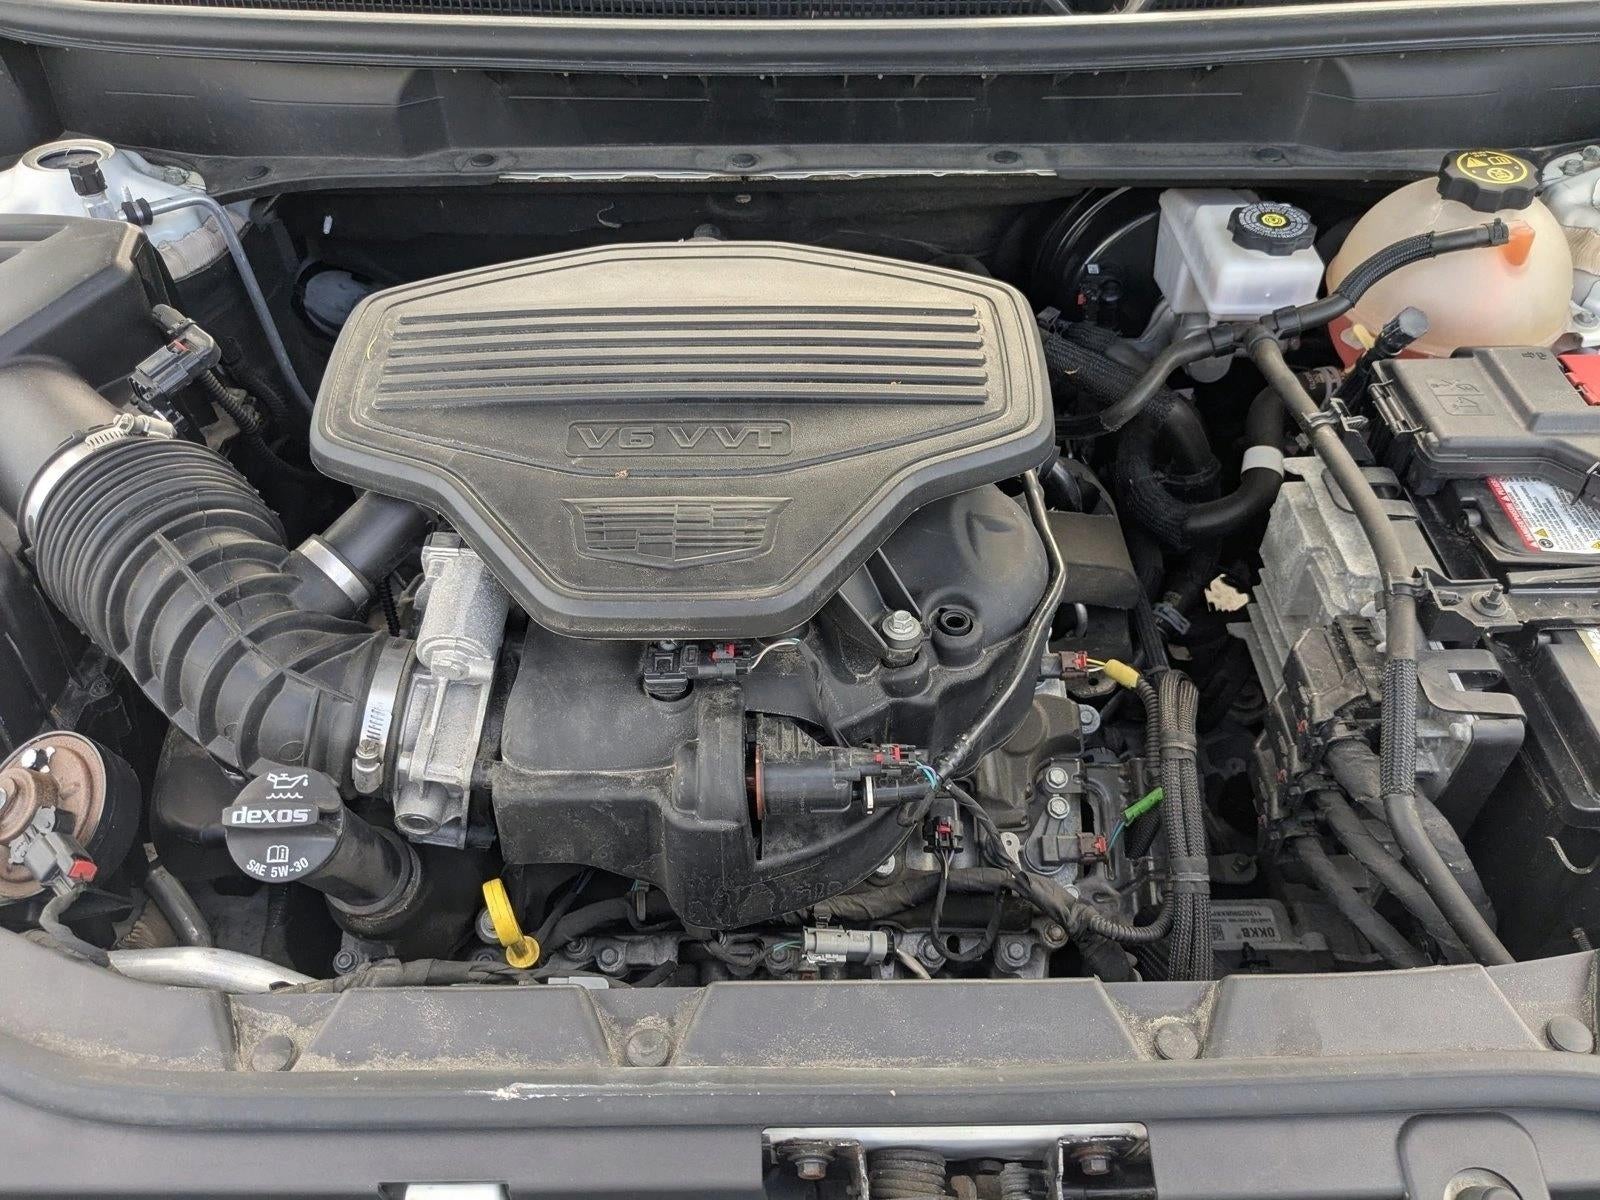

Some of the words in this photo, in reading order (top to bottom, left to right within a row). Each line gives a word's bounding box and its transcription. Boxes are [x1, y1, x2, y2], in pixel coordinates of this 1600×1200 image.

[577, 426, 655, 449] V6
[667, 426, 783, 449] VVT
[231, 806, 309, 824] dexos
[246, 859, 267, 877] SAE
[270, 857, 309, 878] 5W-30
